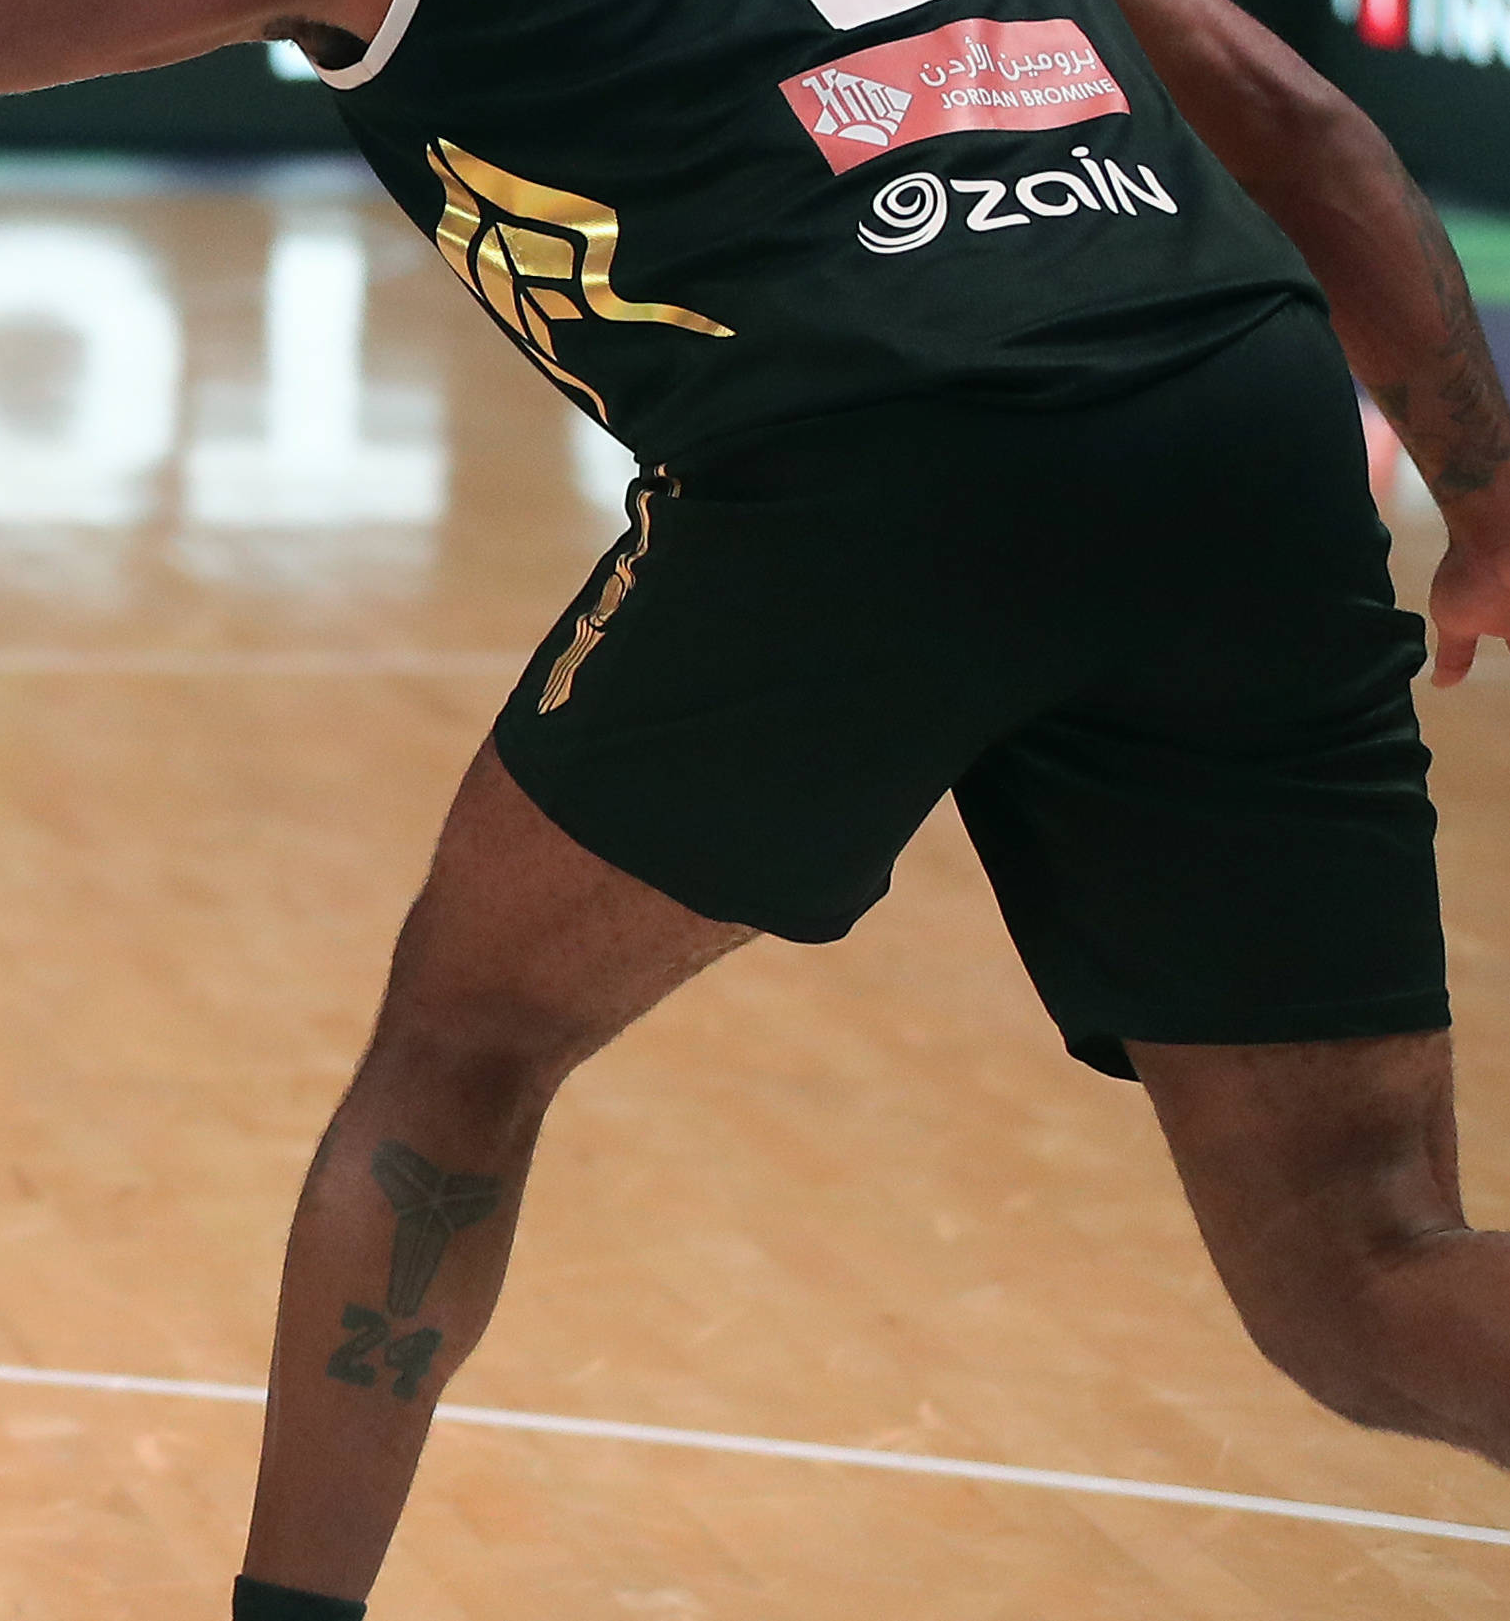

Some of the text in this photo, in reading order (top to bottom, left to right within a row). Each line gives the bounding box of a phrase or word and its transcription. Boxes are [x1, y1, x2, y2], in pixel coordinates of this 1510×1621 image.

[920, 36, 1096, 87] برومين الأردن
[941, 78, 1117, 111] JORDAN BROMINE
[325, 1301, 444, 1401] 24
